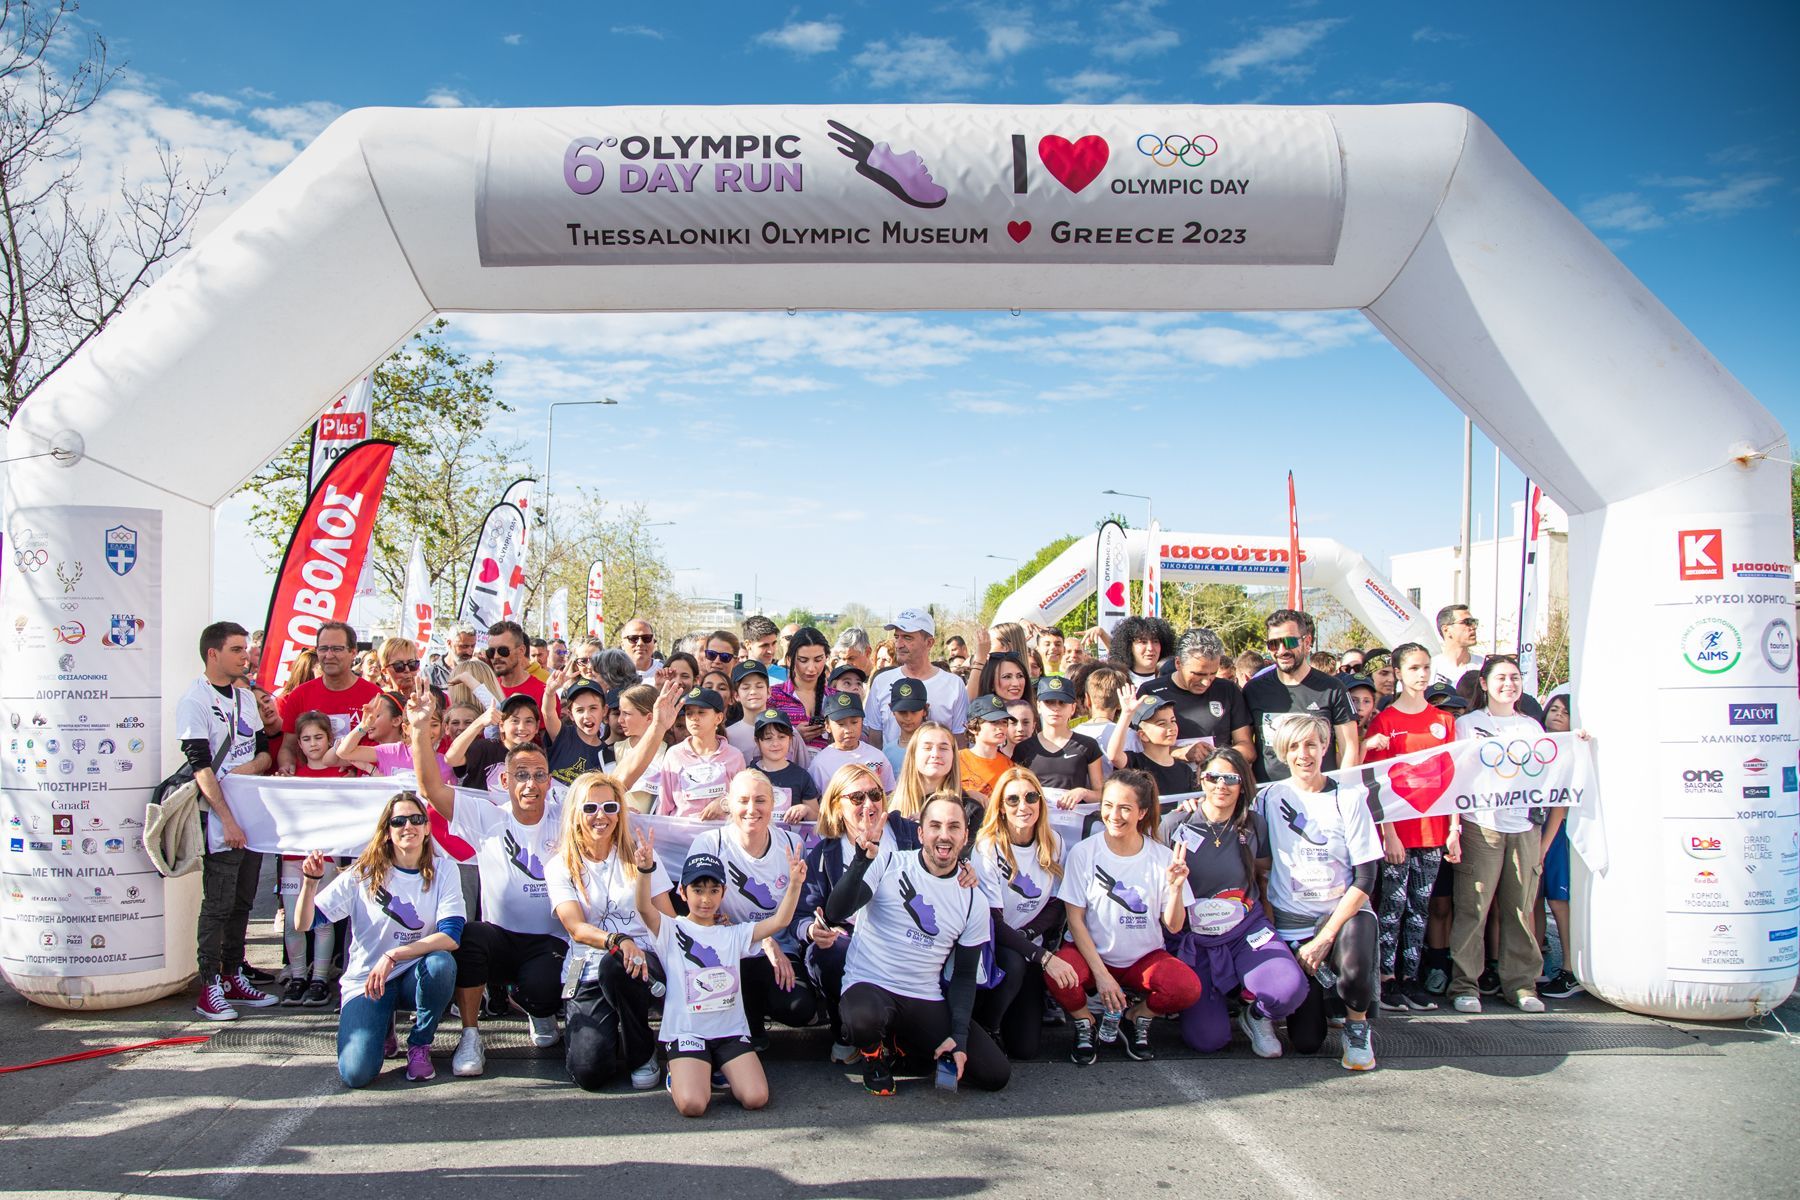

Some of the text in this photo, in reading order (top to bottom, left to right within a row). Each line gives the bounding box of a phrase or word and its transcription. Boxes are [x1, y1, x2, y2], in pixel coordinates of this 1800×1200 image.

[620, 135, 802, 160] OLYMPIC
[1011, 134, 1028, 194] I
[619, 162, 803, 193] DAY RUN
[1110, 178, 1250, 195] OLYMPIC DAY
[761, 221, 871, 244] OLYMPIC
[882, 221, 988, 244] MUSEUM
[1050, 220, 1175, 244] GREECE
[1182, 221, 1247, 244] 2023
[1695, 594, 1744, 604] ΧΡΥΣΟΙ
[1697, 651, 1729, 661] AIMS
[36, 690, 108, 700] ΔΙΟΡΓΑΝΩΣΗ
[1701, 734, 1792, 743] ΧΑΛΚΙΝΟΣ ΧΟΡΗΓΟΣ
[1683, 770, 1724, 782] one
[38, 782, 108, 792] ΥΠΟΣΤΗΡΙΞΗ
[1455, 788, 1584, 810] OLYMPIC DAY
[52, 800, 90, 810] Canada
[1737, 811, 1777, 819] ΧΟΡΗΓΟΙ
[1691, 837, 1722, 848] Dole
[688, 856, 720, 866] LEFKADA
[32, 868, 115, 878] ΜΕ ΤΗΝ ΑΙΓΙΔΑ
[16, 913, 140, 924] ΥΠΟΣΤΗΡΙΞΗ ΔΡΟΜΙΚΗΣ ΕΜΠΕΙΡΙΑΣ
[25, 954, 128, 964] ΥΠΟΣΤΗΡΙΞΗ ΤΡΟΦΟΔΟΣΙΑΣ
